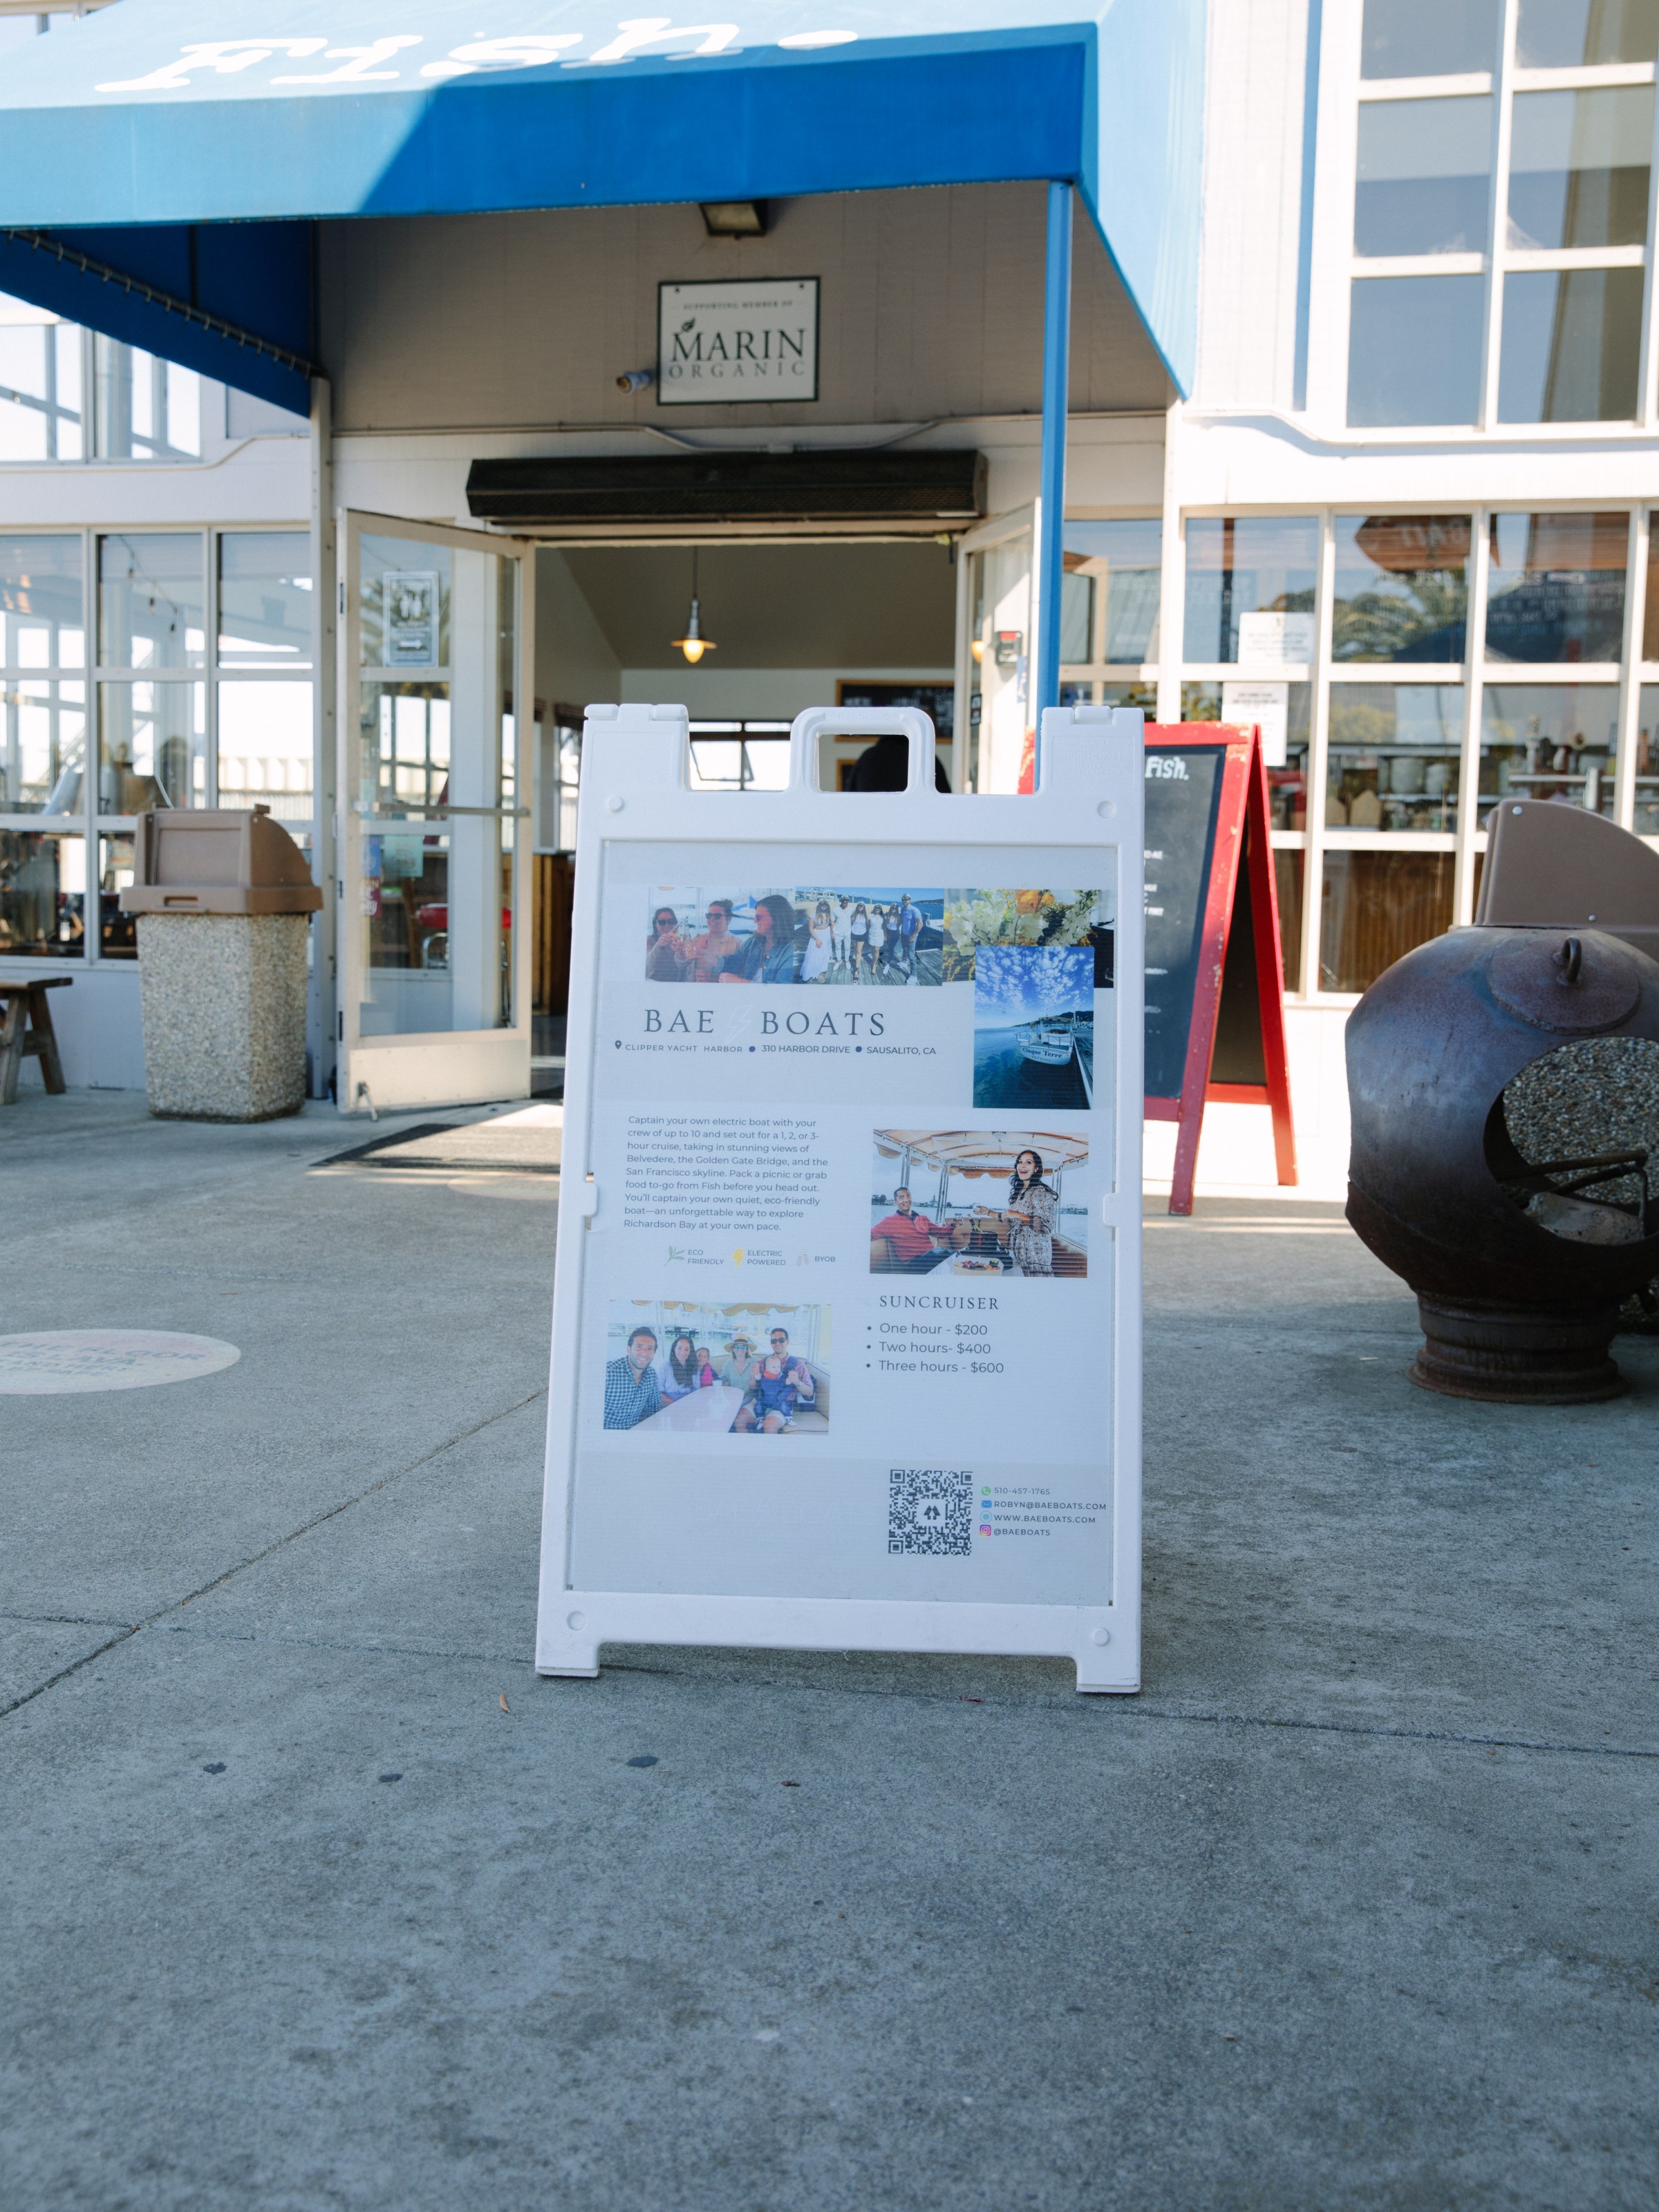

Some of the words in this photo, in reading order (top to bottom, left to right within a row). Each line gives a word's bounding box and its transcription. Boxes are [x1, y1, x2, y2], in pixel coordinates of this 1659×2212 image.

[95, 17, 859, 93] Fish.
[671, 328, 805, 362] MARIN
[668, 360, 805, 379] ORGANIC
[1145, 756, 1190, 780] Fish.
[644, 1009, 715, 1033] BAE
[760, 1011, 885, 1037] BOATS
[625, 1043, 664, 1051] CLIPPER
[762, 1044, 776, 1053] 310
[778, 1045, 820, 1053] HARBOR
[822, 1046, 851, 1054] DRIVE
[867, 1047, 921, 1056] SAUSALITO,
[923, 1047, 937, 1056] CA
[1043, 1050, 1062, 1058] Terre
[628, 1116, 664, 1126] Captain
[666, 1118, 688, 1127] your
[712, 1117, 747, 1126] electric
[749, 1118, 771, 1126] boat
[772, 1118, 794, 1127] with
[794, 1121, 817, 1130] your
[652, 1129, 663, 1137] of
[664, 1131, 677, 1139] up
[702, 1130, 721, 1138] and
[757, 1131, 771, 1139] for
[780, 1132, 787, 1141] 1,
[788, 1132, 796, 1142] 2,
[809, 1132, 820, 1140] 3-
[627, 1141, 650, 1150] hour
[651, 1142, 682, 1152] cruise,
[683, 1143, 714, 1153] taking
[715, 1143, 725, 1151] in
[727, 1143, 769, 1154] stunning
[771, 1144, 798, 1153] views
[799, 1145, 810, 1153] of
[627, 1154, 675, 1165] Belvedere,
[677, 1155, 694, 1164] the
[695, 1156, 729, 1164] Golden
[731, 1156, 754, 1165] Gate
[756, 1157, 790, 1168] Bridge,
[791, 1158, 810, 1166] and
[812, 1158, 828, 1166] the
[646, 1168, 691, 1177] Francisco
[692, 1169, 727, 1179] skyline.
[762, 1170, 791, 1181] picnic
[805, 1171, 827, 1181] grab
[625, 1180, 647, 1188] food
[648, 1181, 675, 1192] to-go
[676, 1181, 699, 1190] from
[702, 1181, 721, 1190] Fish
[723, 1182, 753, 1190] before
[754, 1184, 773, 1193] you
[775, 1183, 799, 1192] head
[652, 1194, 687, 1204] captain
[688, 1197, 711, 1205] your
[735, 1195, 762, 1206] quiet,
[764, 1196, 821, 1208] eco-friendly
[668, 1207, 734, 1218] unforgettable
[735, 1210, 756, 1219] way
[769, 1209, 804, 1219] explore
[624, 1219, 677, 1228] Richardson
[679, 1220, 697, 1231] Bay
[709, 1223, 732, 1231] your
[756, 1224, 781, 1232] pace.
[879, 1295, 1000, 1310] SUNCRUISER
[880, 1322, 907, 1334] One
[911, 1323, 942, 1335] hour
[955, 1323, 988, 1335] $200
[879, 1342, 906, 1352] Two
[910, 1342, 953, 1353] hours-
[957, 1342, 991, 1355] $400
[879, 1360, 916, 1371] Three
[920, 1360, 958, 1373] hours
[971, 1361, 1004, 1374] $600
[993, 1487, 1051, 1495] 510-457-1765
[994, 1501, 1106, 1510] ROBYN@BAEBOATS.COM
[993, 1514, 1096, 1524] WWW.BAEBOATS.COM
[993, 1528, 1051, 1537] @BAEBOATS
